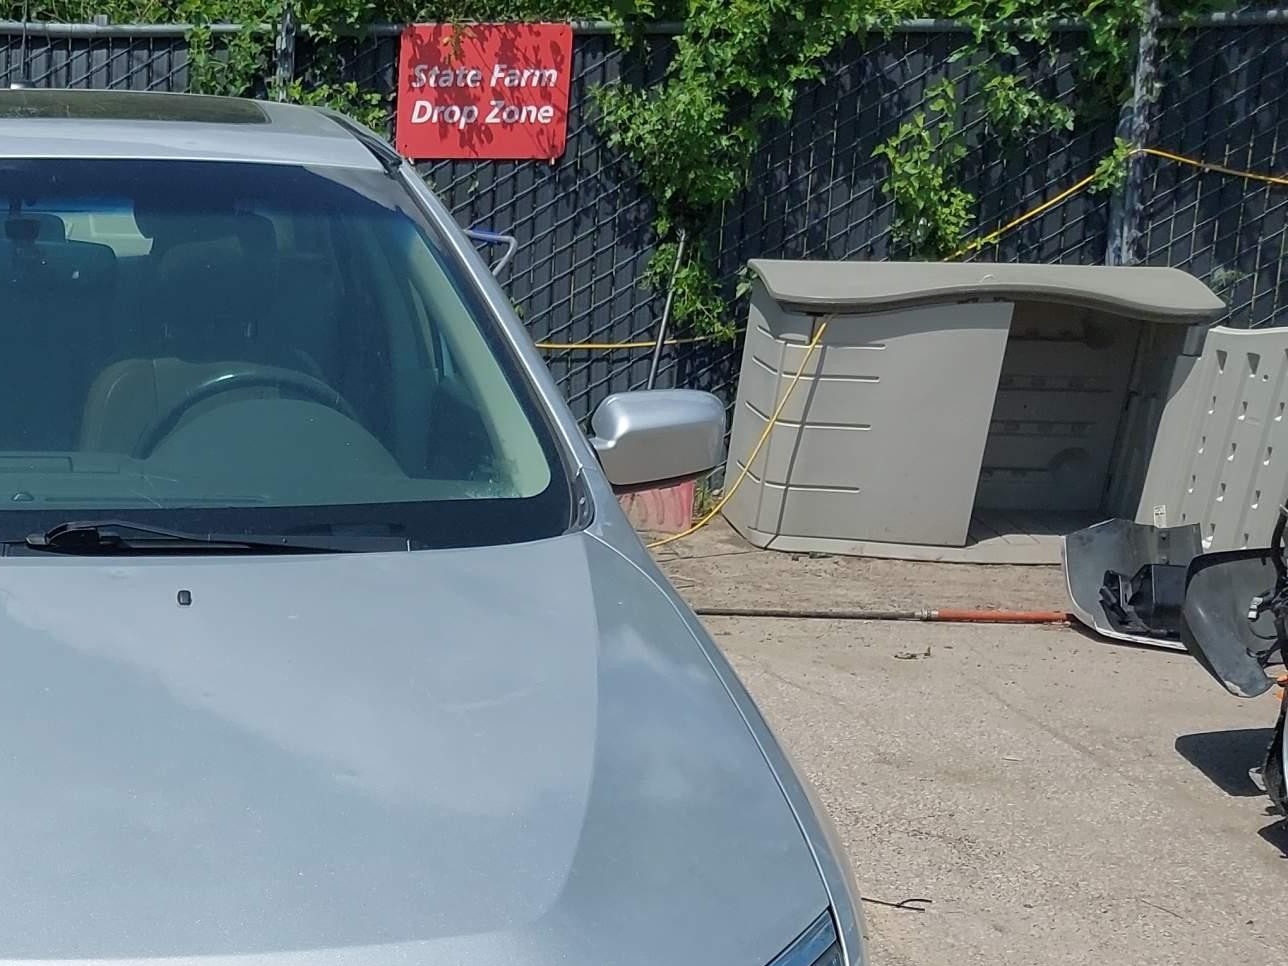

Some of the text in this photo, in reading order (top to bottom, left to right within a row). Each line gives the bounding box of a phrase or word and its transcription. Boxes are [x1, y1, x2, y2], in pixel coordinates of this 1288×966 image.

[411, 64, 558, 88] State Farm
[411, 100, 554, 129] Drop Zone
